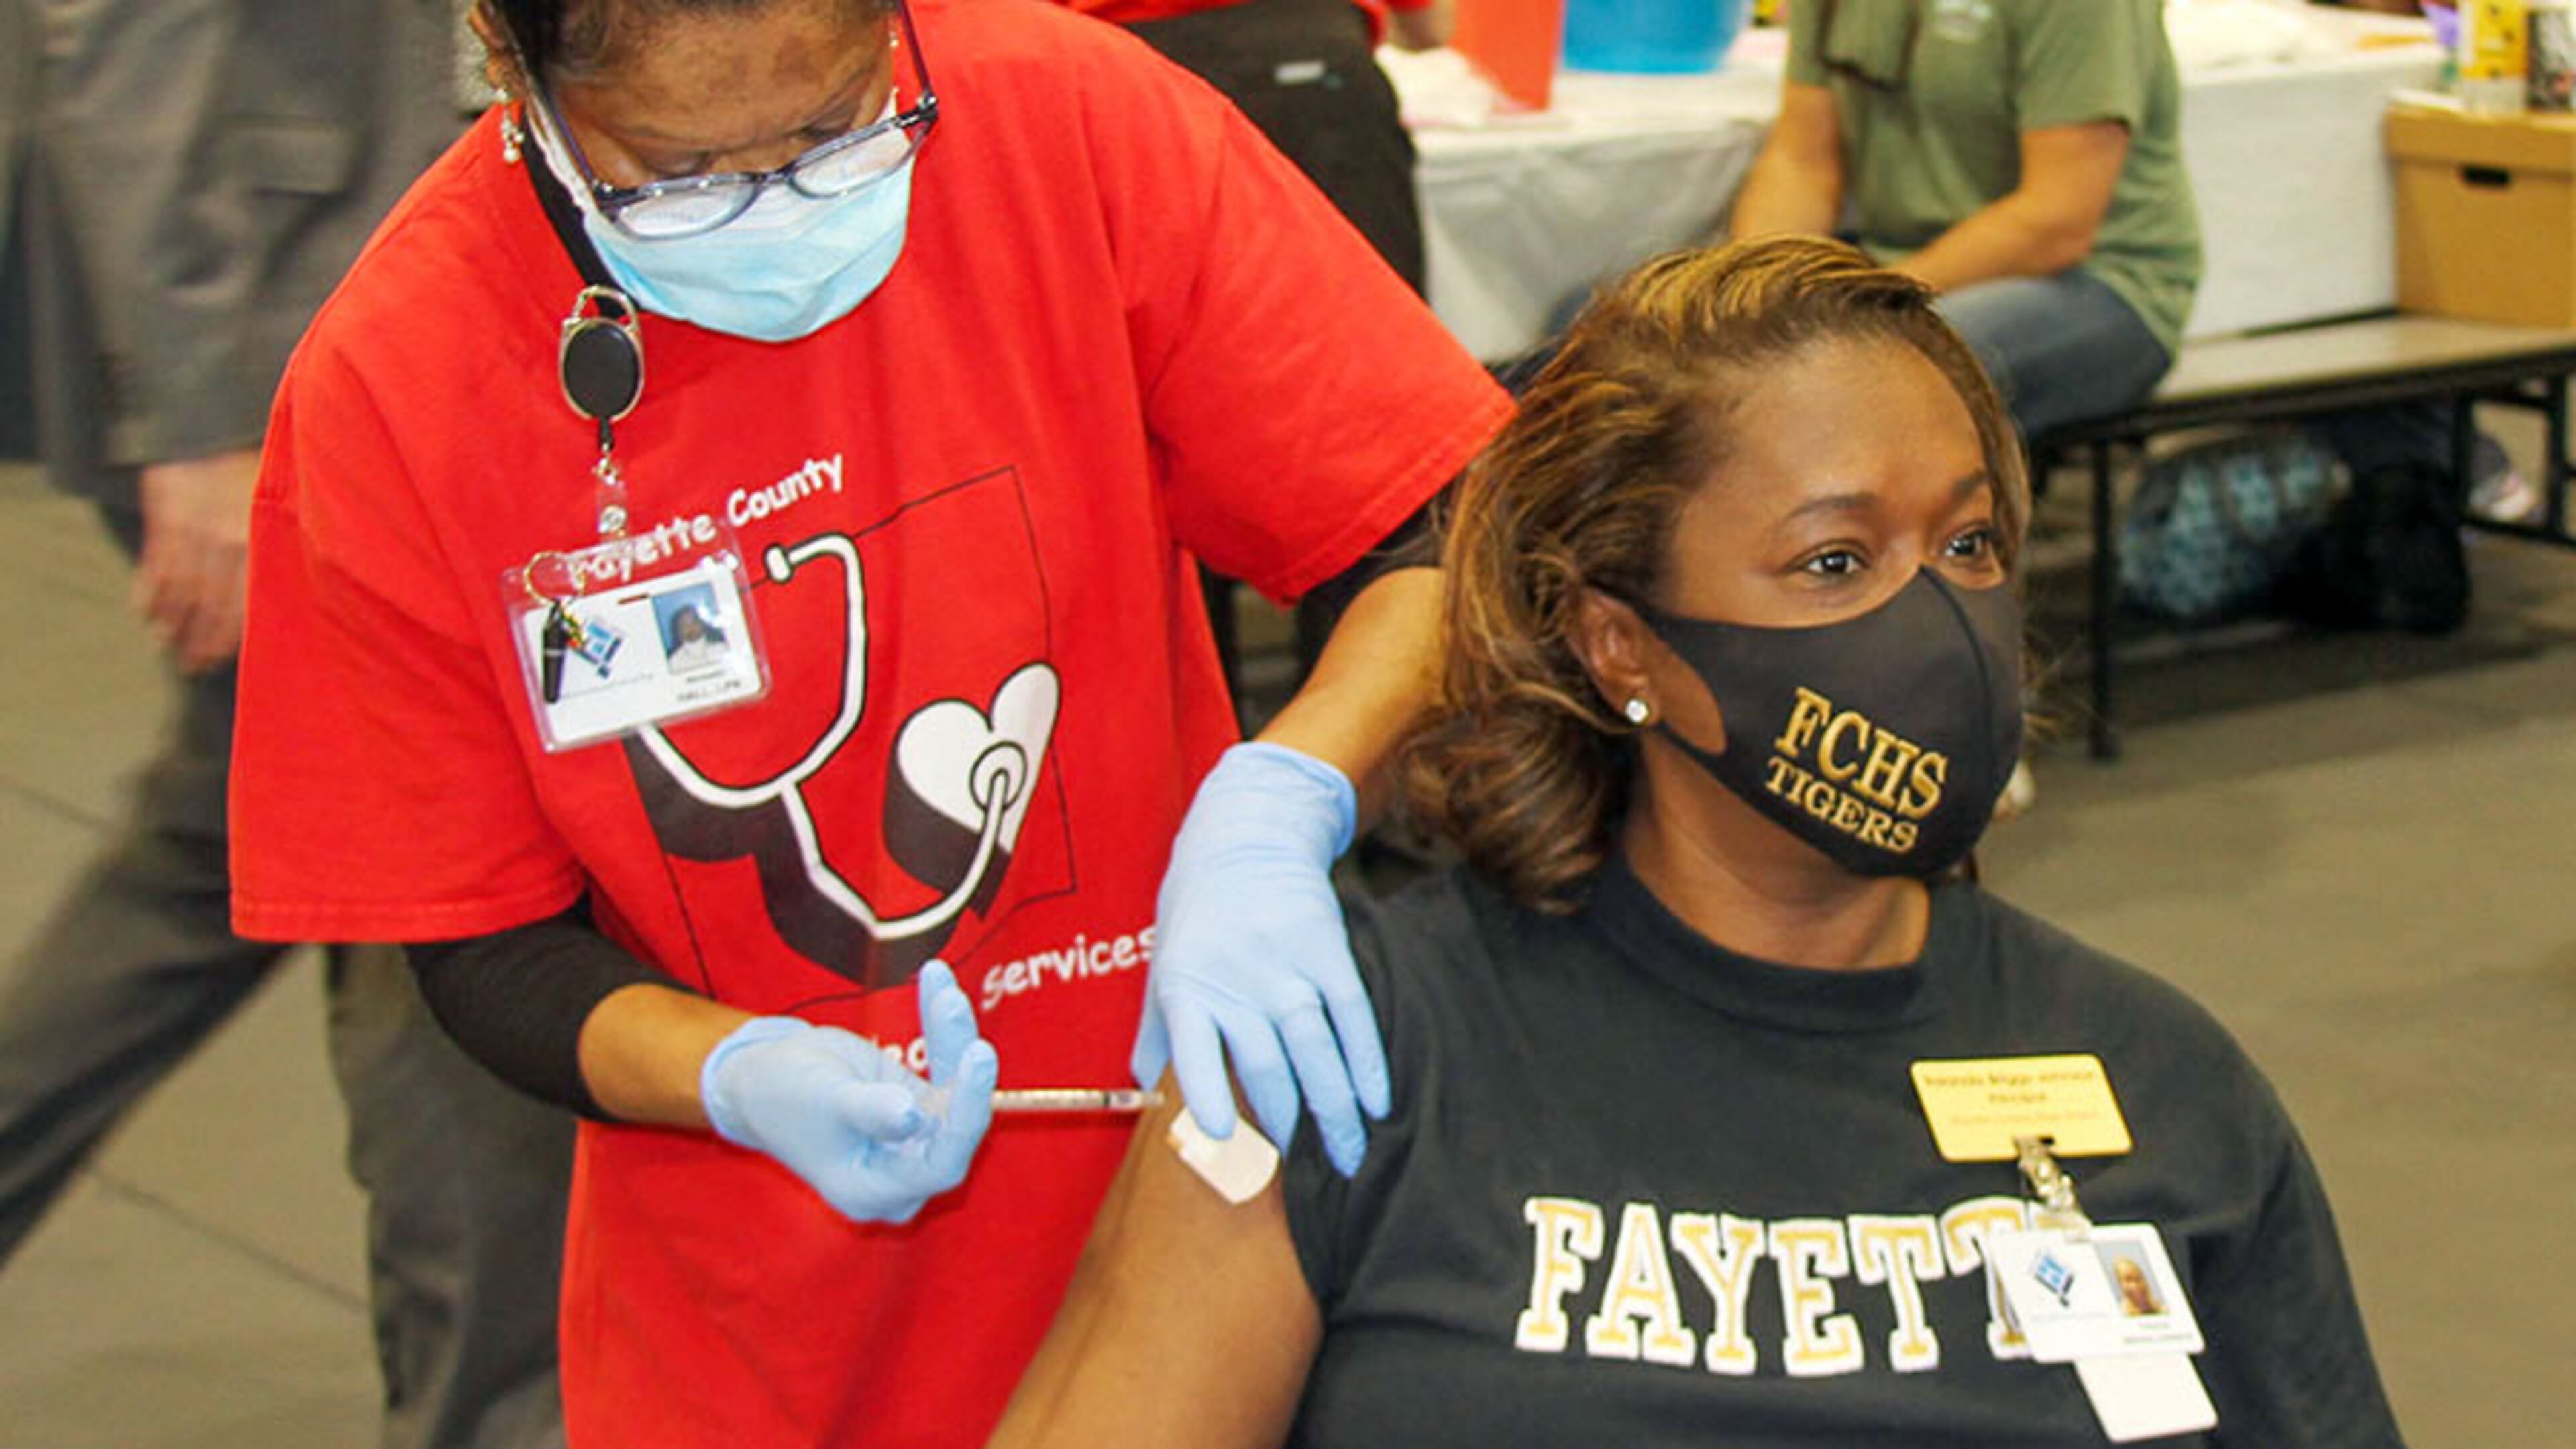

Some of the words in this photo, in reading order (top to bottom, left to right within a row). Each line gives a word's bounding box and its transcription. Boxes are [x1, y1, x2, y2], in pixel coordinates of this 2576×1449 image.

[727, 453, 844, 527] County
[1774, 686, 1949, 820] FCHS
[1765, 756, 1919, 855] TIGERS
[982, 926, 1159, 1011] services
[1515, 1195, 2088, 1377] FAYETT
